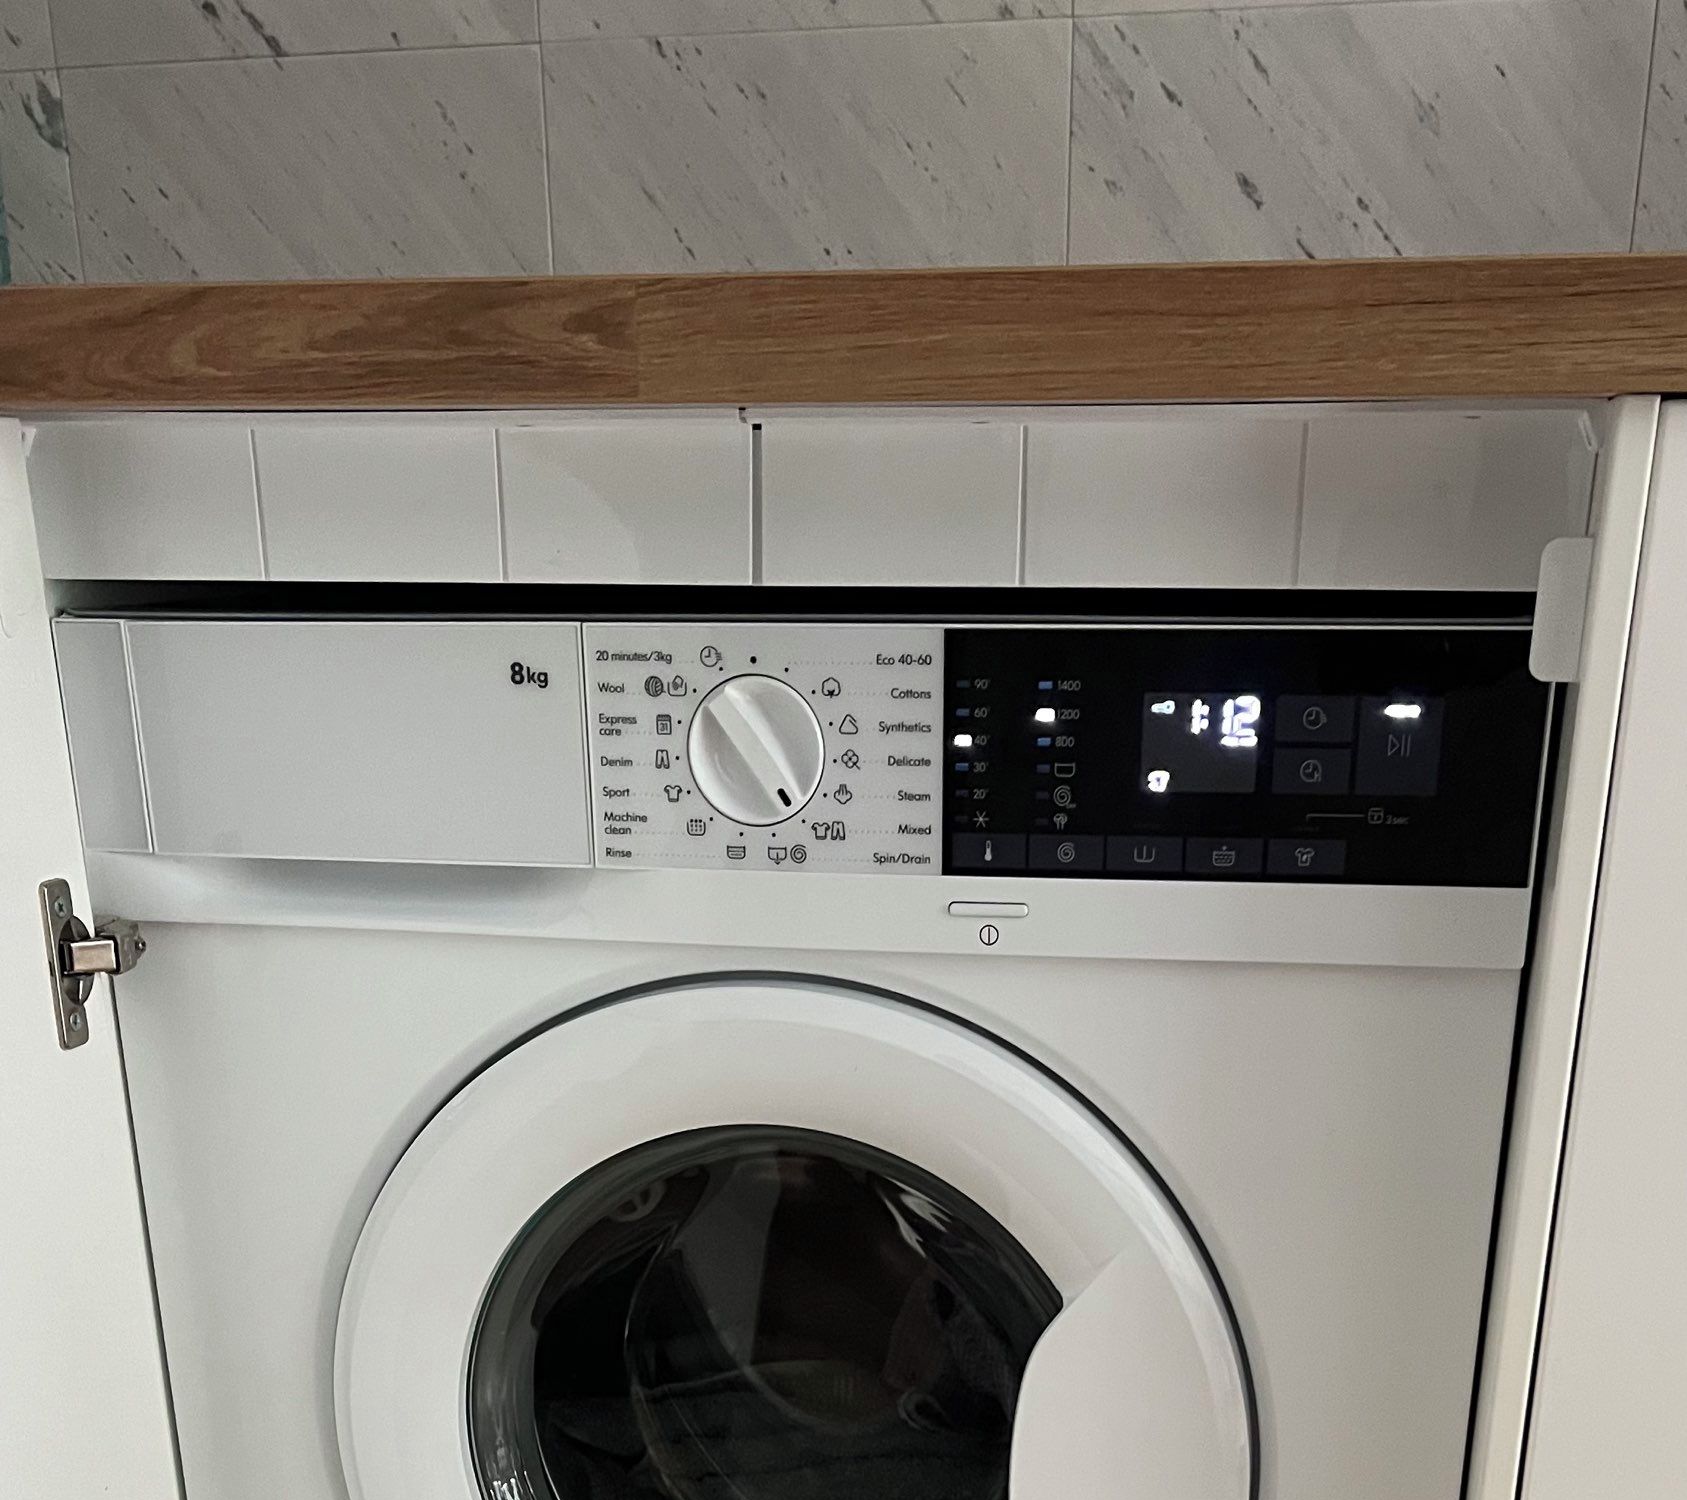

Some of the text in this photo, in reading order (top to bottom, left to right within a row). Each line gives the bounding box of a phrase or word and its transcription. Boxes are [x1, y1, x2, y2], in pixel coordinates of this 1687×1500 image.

[596, 650, 673, 664] 20 minutes/3kg
[876, 654, 932, 666] Eco 40-60
[510, 662, 549, 689] 8kg
[597, 682, 625, 694] Wool
[1057, 680, 1081, 691] 1400
[890, 688, 932, 700] Cottons
[598, 713, 637, 726] Express
[1057, 708, 1080, 720] 1200
[599, 728, 622, 737] care
[878, 721, 932, 735] Synthetics
[1055, 736, 1075, 748] 800
[600, 756, 633, 767] Denim
[887, 755, 932, 767] Delicate
[602, 786, 630, 799] Sport
[897, 790, 931, 802] Steam
[603, 812, 648, 823] Machine
[604, 824, 632, 835] clean
[897, 824, 932, 835] Mixed
[605, 847, 632, 858] Rinse
[872, 852, 931, 866] Spin/Drain
